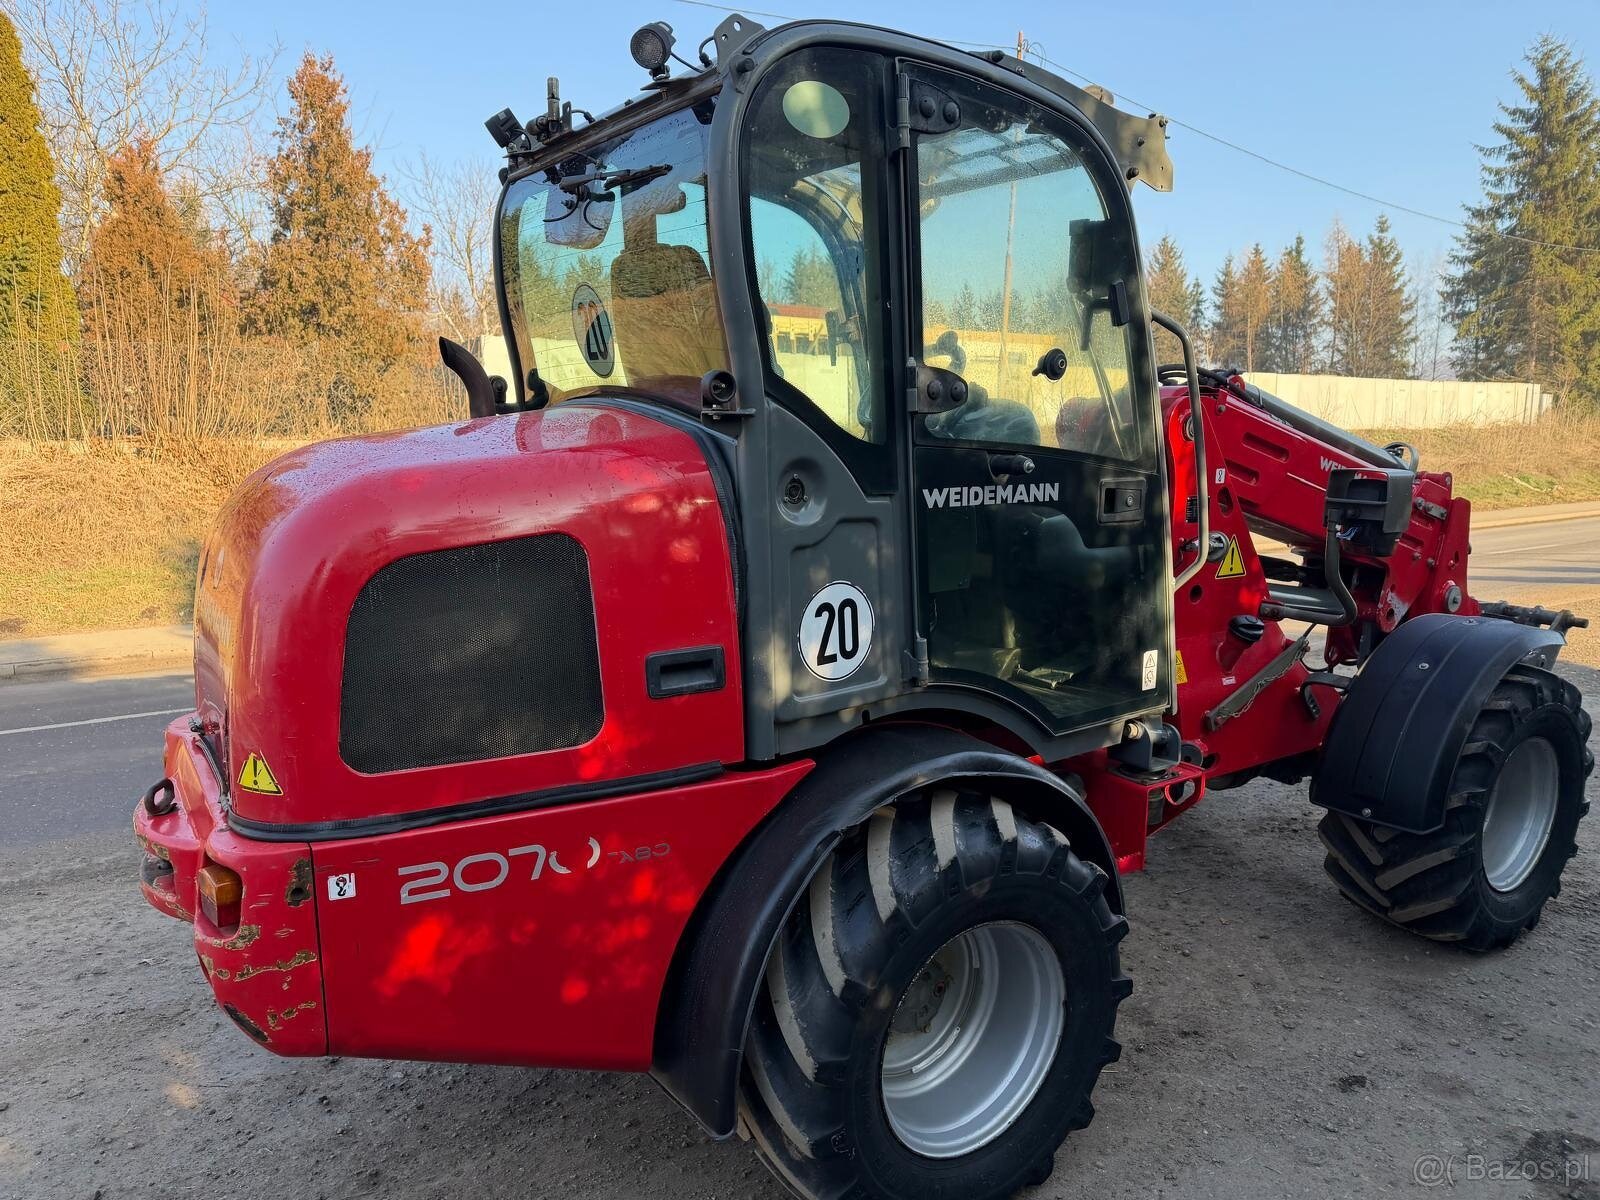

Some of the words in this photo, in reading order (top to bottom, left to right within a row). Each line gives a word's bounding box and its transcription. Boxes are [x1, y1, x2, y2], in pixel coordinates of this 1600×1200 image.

[577, 300, 609, 361] 20
[922, 482, 1060, 509] WEIDEMANN
[814, 597, 859, 667] 20
